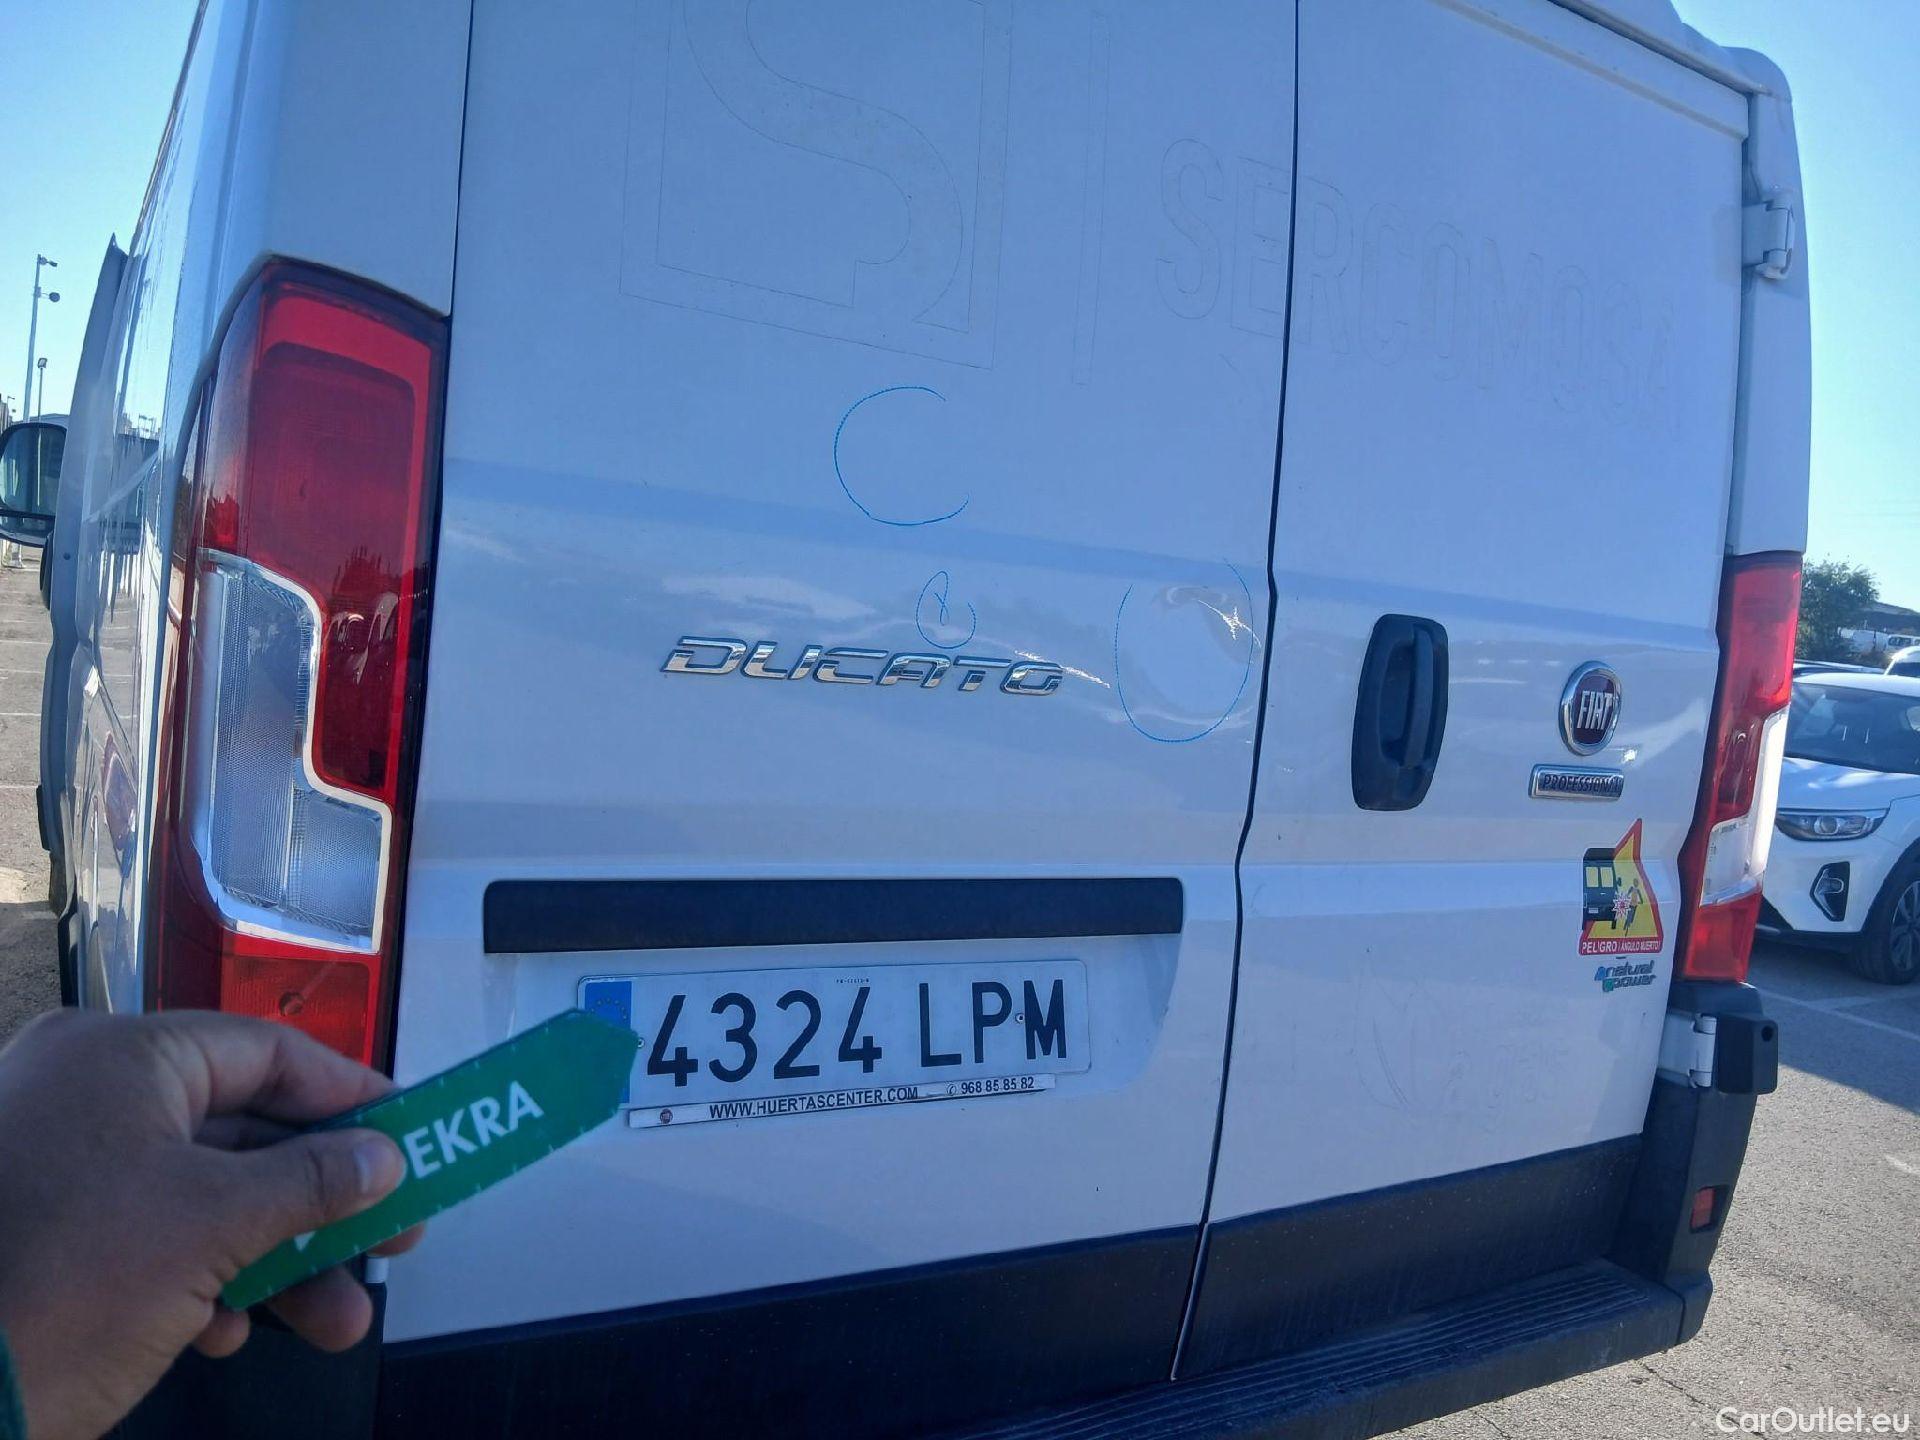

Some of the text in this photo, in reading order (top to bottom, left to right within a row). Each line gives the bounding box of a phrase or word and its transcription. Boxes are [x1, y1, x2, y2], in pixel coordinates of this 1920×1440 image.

[661, 635, 1063, 696] DUCATO
[1577, 690, 1613, 730] FIAT
[1543, 774, 1623, 796] PROFESSIONAL
[1582, 941, 1617, 954] PELIGRO
[1606, 960, 1655, 977] natural
[647, 979, 1067, 1087] 4324 LPM
[709, 1076, 1035, 1119] WWW.HUERTASCENTER.COM 968 85 85 82
[403, 1080, 545, 1179] EKRA
